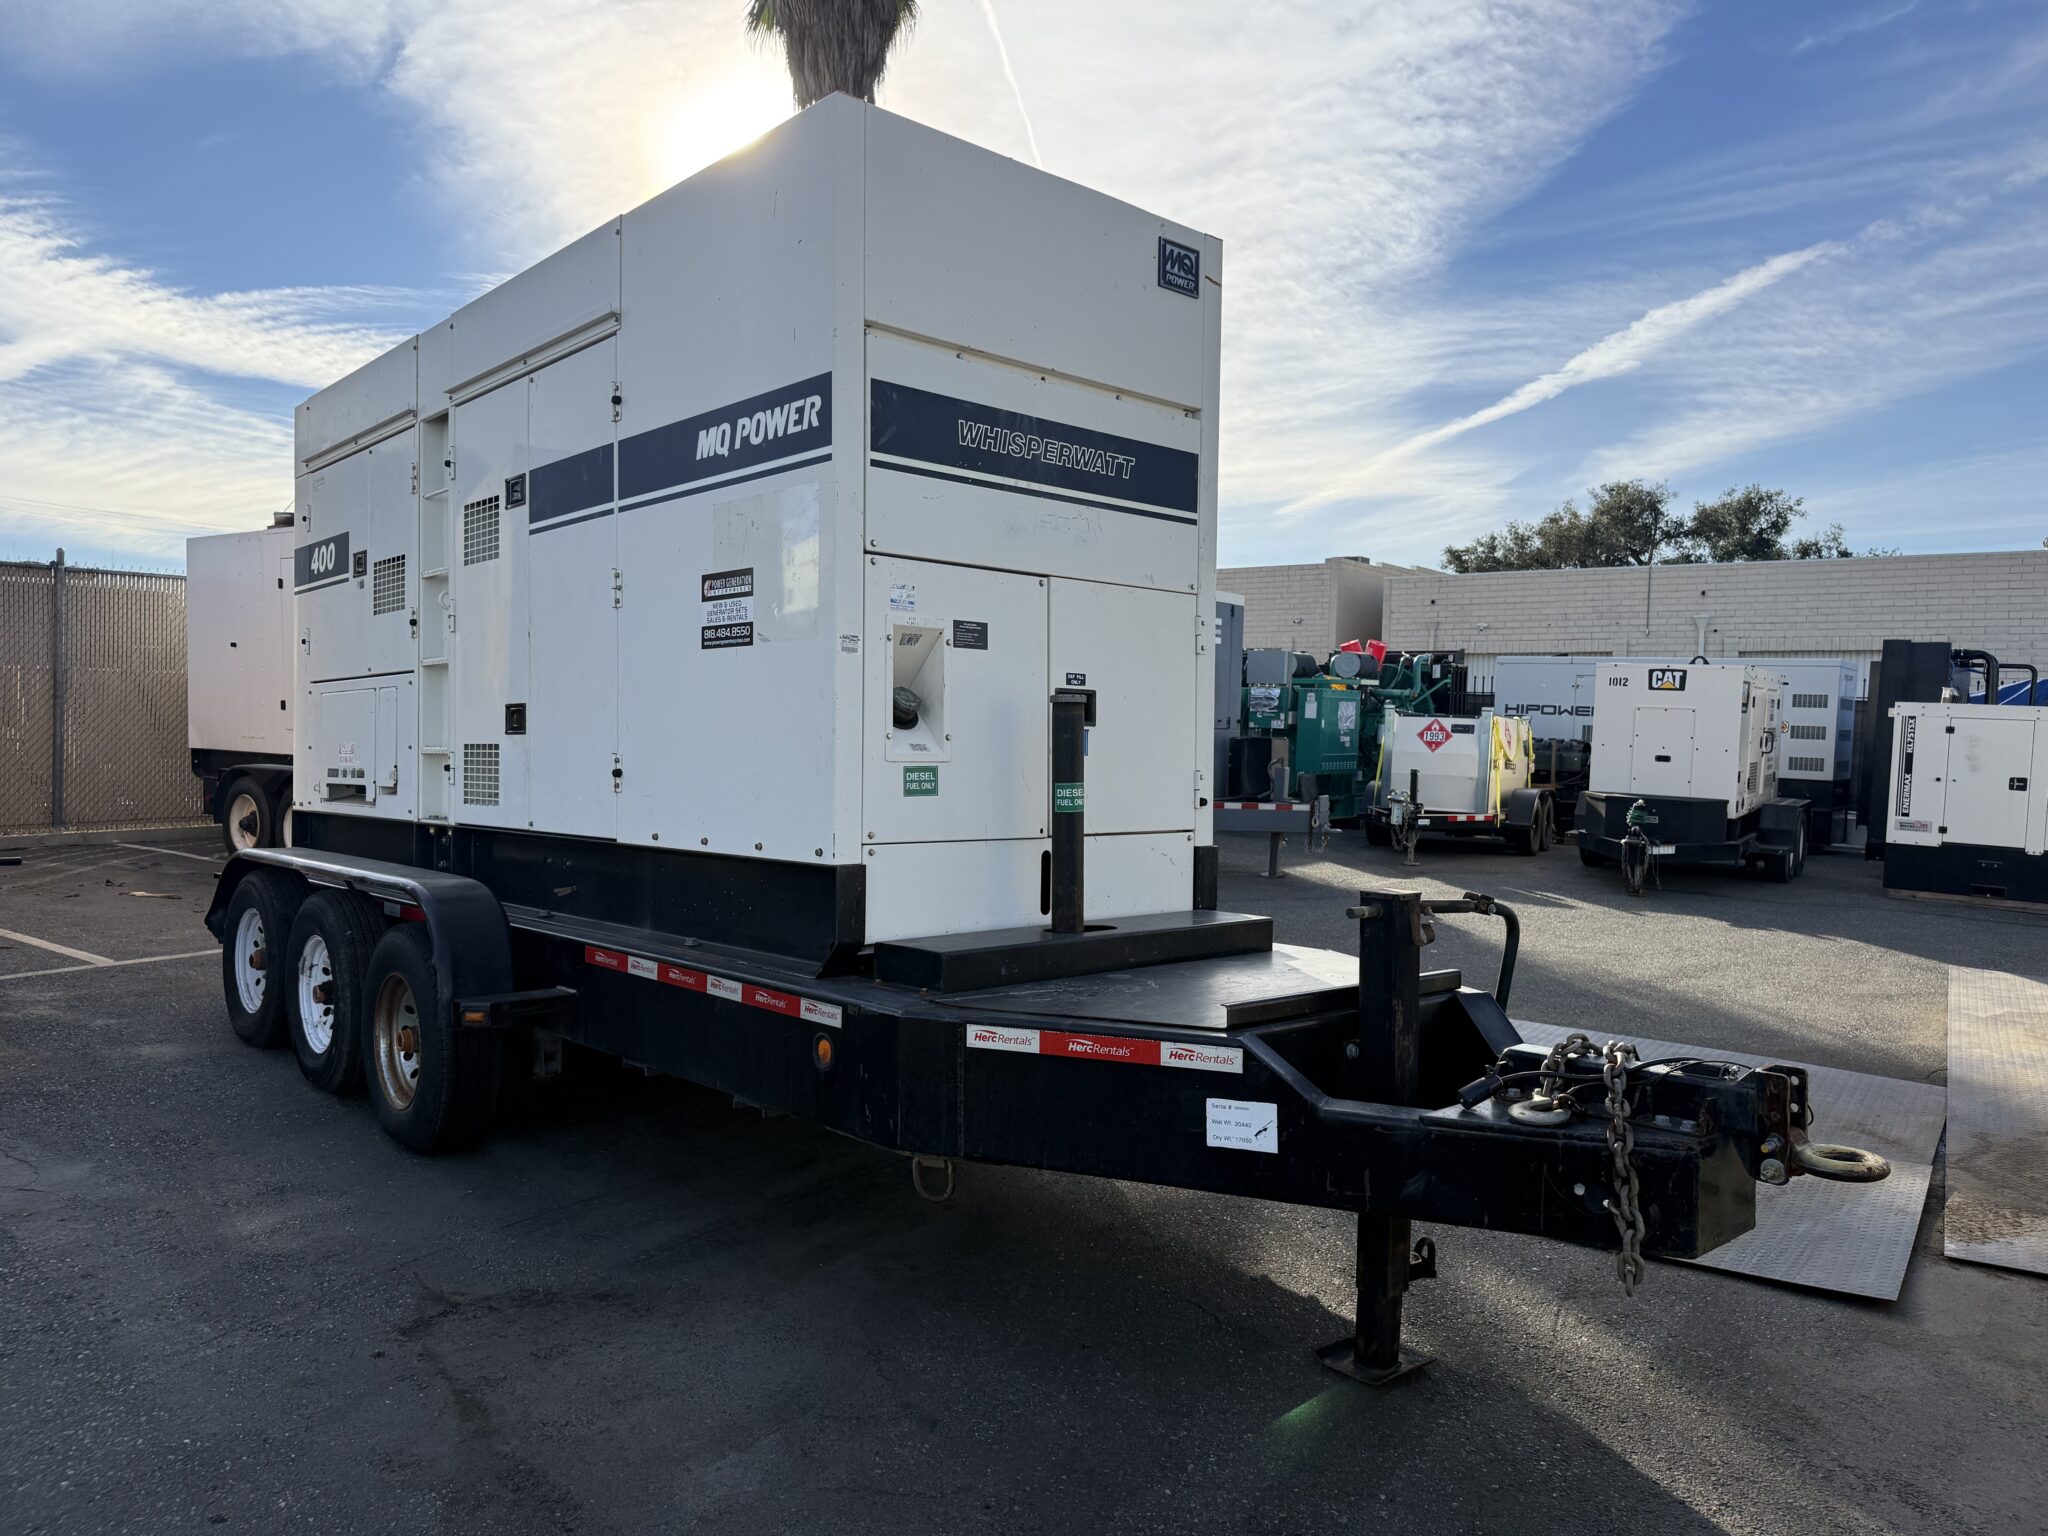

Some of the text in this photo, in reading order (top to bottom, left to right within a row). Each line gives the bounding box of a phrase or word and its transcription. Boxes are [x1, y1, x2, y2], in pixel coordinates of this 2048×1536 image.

[1166, 249, 1195, 275] MQ
[1166, 273, 1195, 290] POWER
[696, 395, 822, 461] MQ POWER
[958, 419, 1135, 479] WHISPERWATT
[311, 542, 336, 575] 400
[712, 579, 726, 589] POWER
[729, 600, 742, 608] USED
[707, 606, 748, 617] GENERATOR SETS
[707, 616, 722, 624] SALES
[727, 613, 748, 622] RENTALS
[704, 626, 751, 639] 818.484.8550
[1608, 676, 1629, 687] 1012
[1651, 670, 1683, 689] CAT
[1425, 731, 1445, 741] 1993
[1906, 718, 1917, 754] KL75TSX
[906, 772, 936, 781] DIESEL
[906, 781, 936, 790] FUEL ONLY
[1057, 788, 1084, 797] DIESE
[1902, 773, 1912, 814] ENERMAX
[1057, 798, 1073, 806] FUEL
